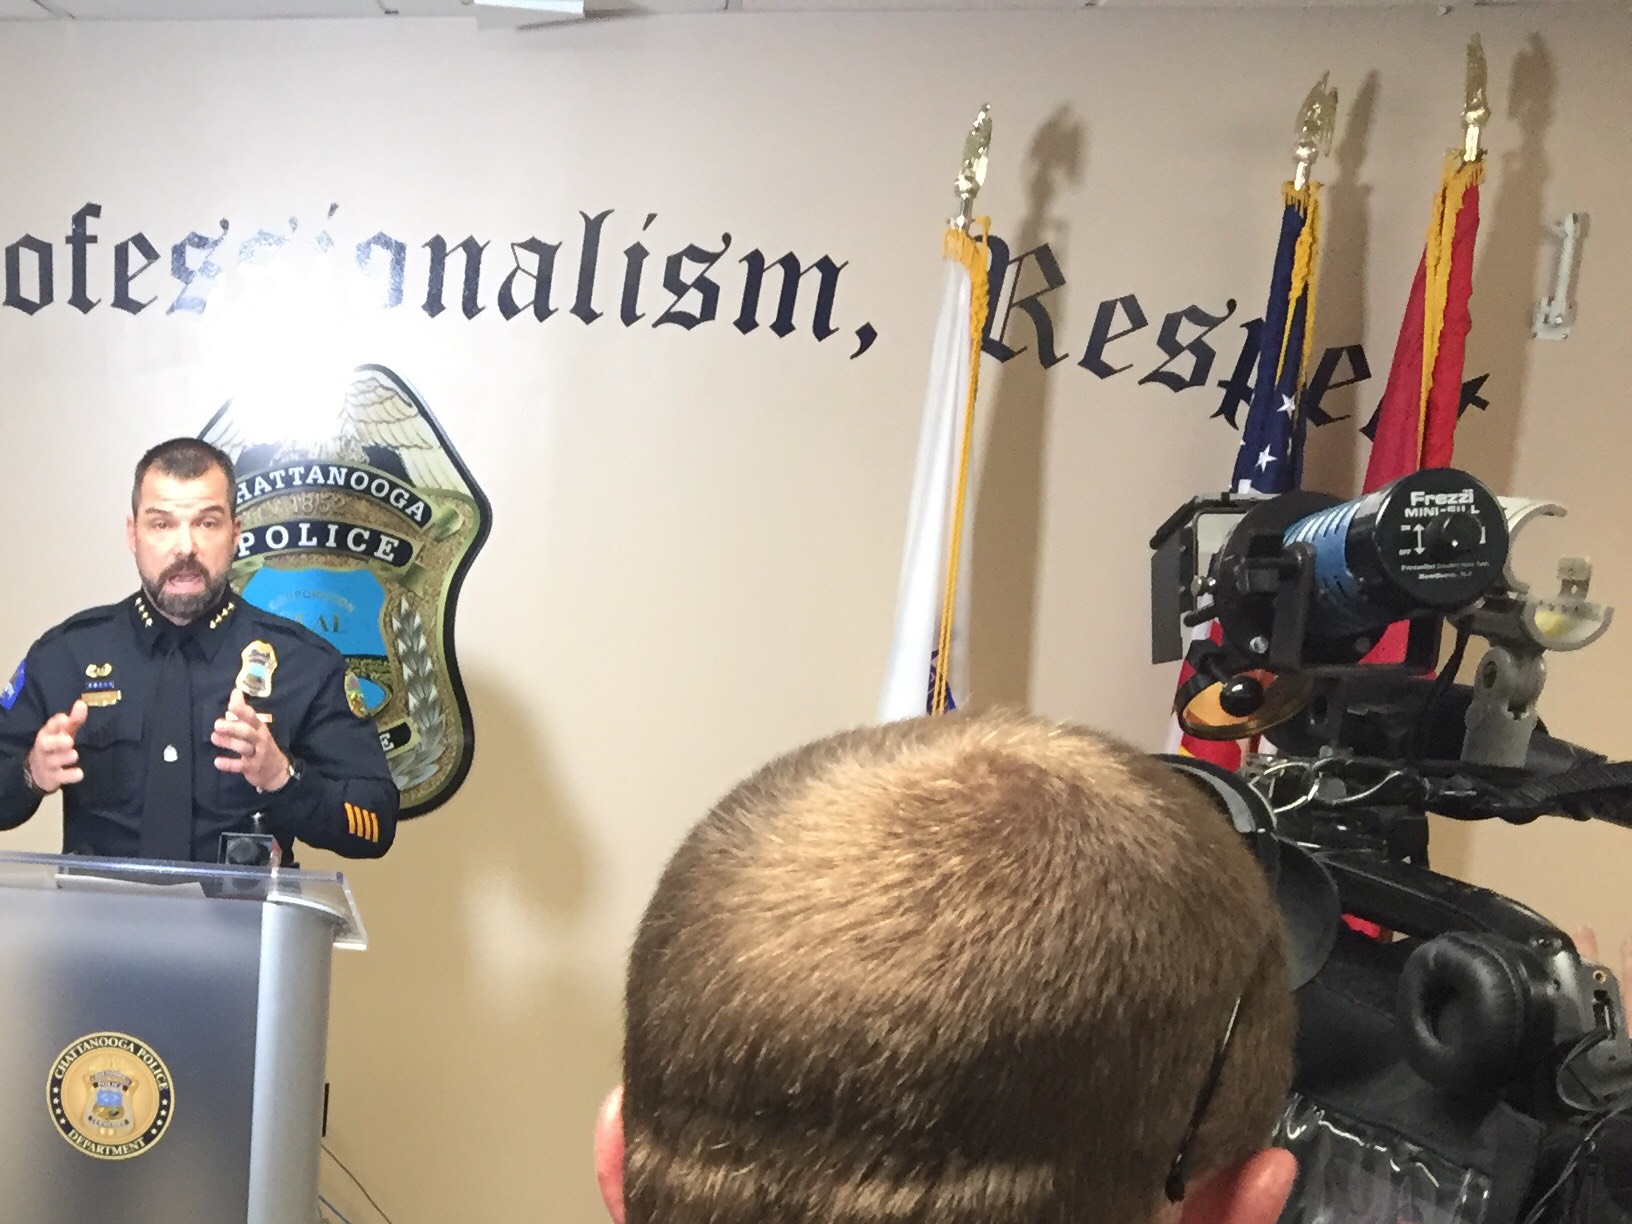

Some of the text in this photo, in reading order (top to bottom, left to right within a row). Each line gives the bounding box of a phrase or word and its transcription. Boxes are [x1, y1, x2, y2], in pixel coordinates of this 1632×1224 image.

[973, 235, 1490, 442] Rese
[236, 465, 426, 522] HATTANOOGA
[1410, 488, 1474, 506] Frezzi
[237, 522, 400, 562] POLICE
[54, 1037, 169, 1090] CHATTANOOGA POLICE
[67, 1129, 146, 1156] DEPARTMENT
